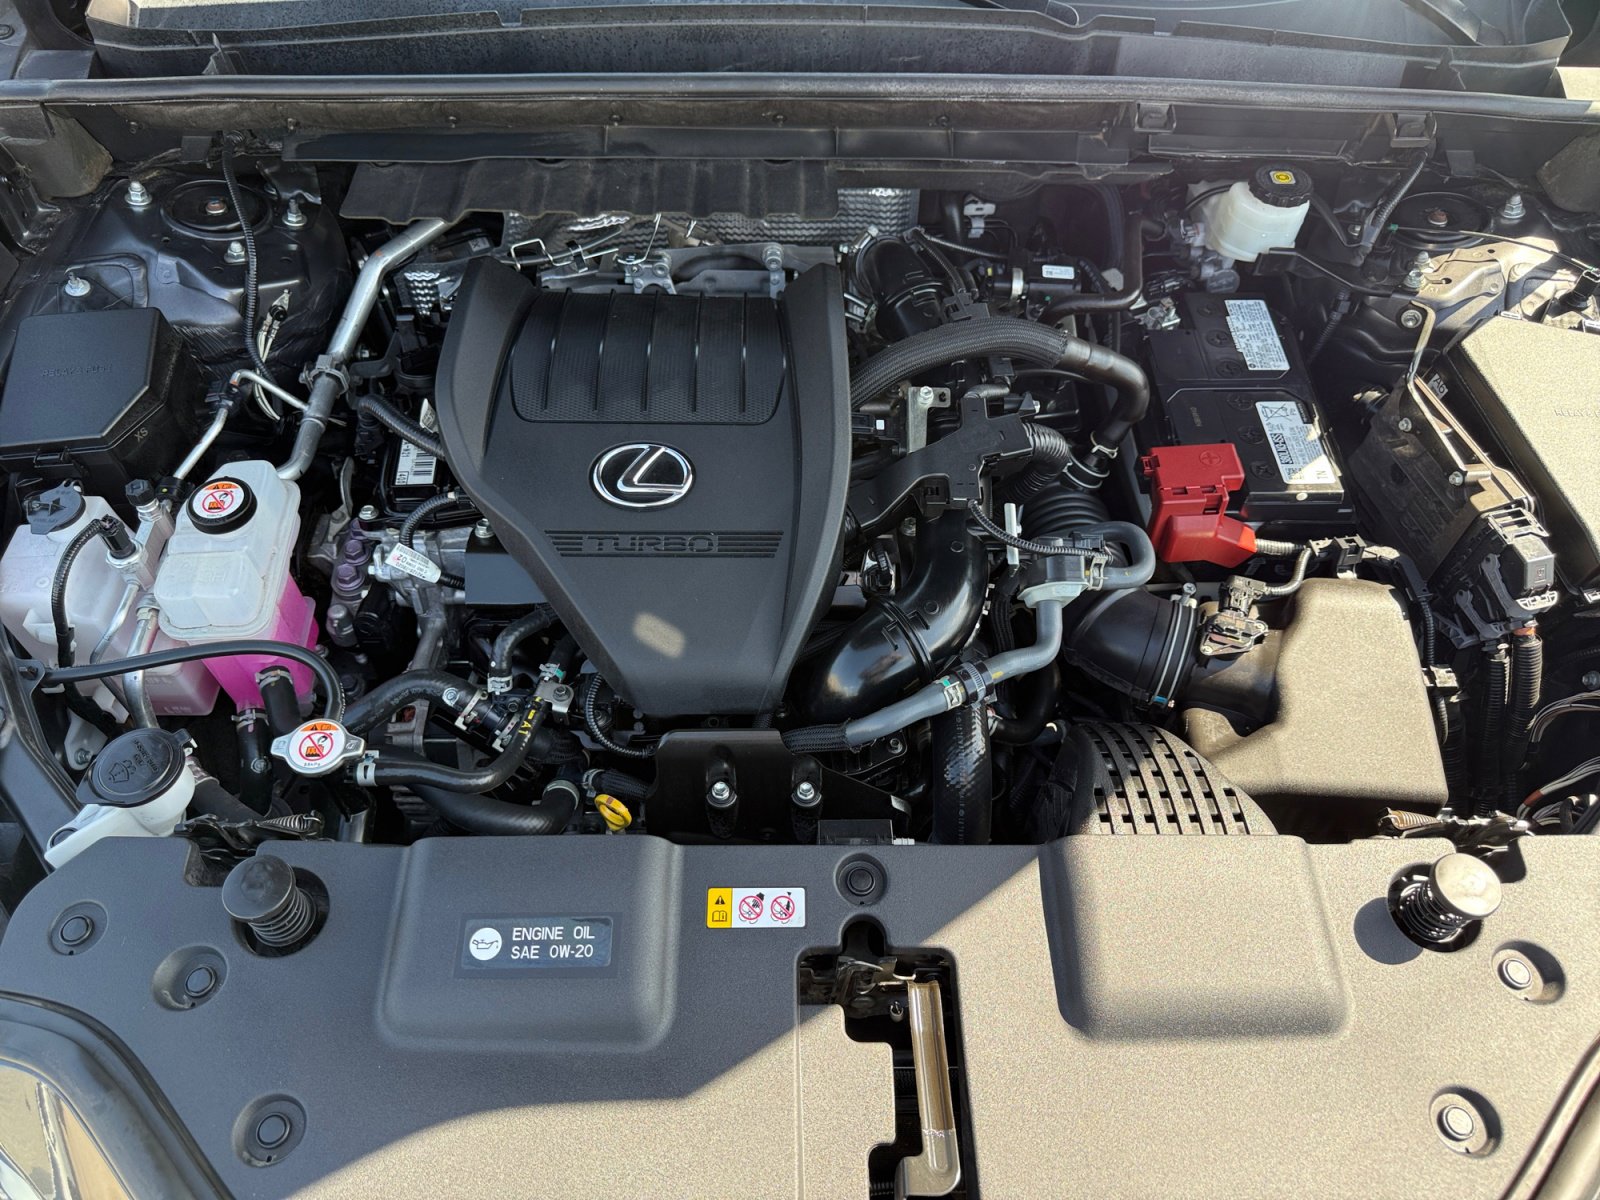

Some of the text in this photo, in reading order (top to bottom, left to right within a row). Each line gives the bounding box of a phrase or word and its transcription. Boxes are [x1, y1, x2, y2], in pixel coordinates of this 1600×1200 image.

[1433, 377, 1446, 394] A6
[134, 427, 149, 443] XS
[587, 534, 714, 552] TURBO
[396, 553, 408, 564] 02
[517, 720, 532, 735] A1
[512, 926, 595, 941] ENGINE OIL
[511, 944, 594, 959] SAE 0W-20
